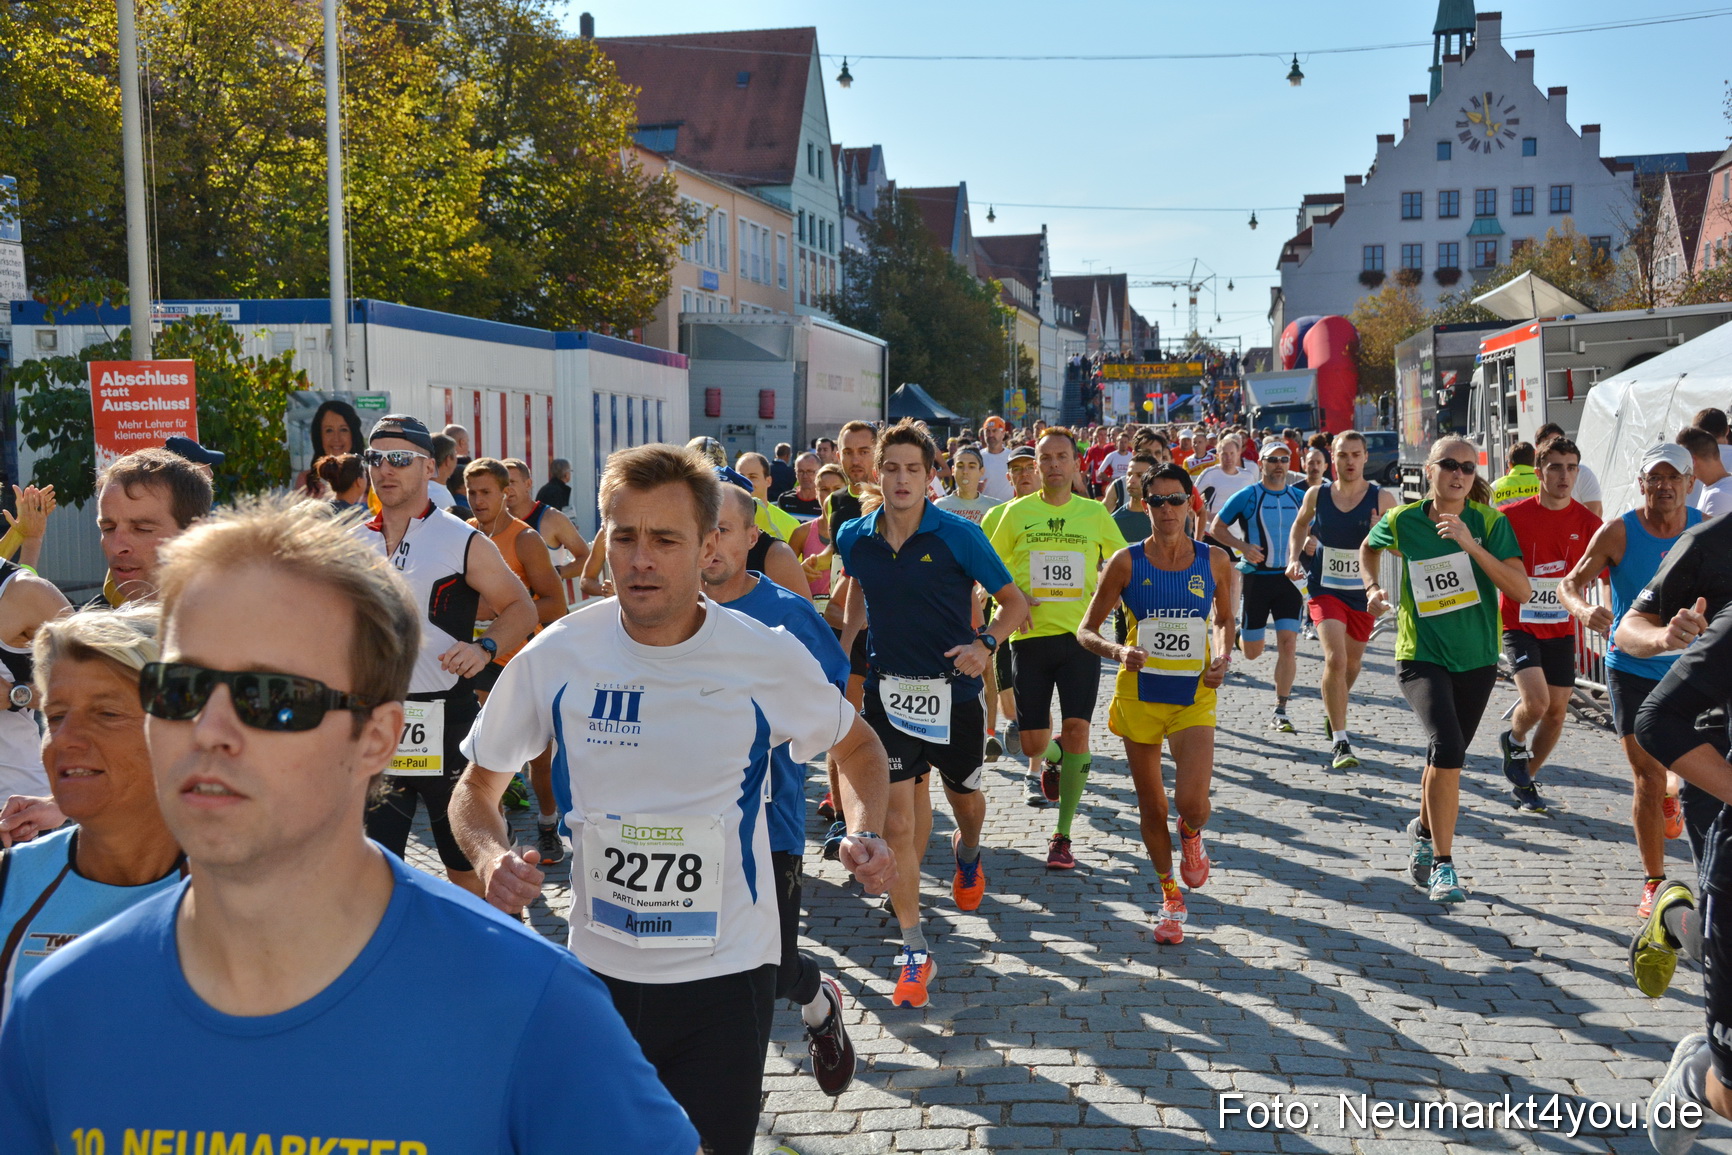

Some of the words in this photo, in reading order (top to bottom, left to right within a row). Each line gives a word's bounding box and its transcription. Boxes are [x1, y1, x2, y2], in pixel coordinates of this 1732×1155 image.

[1135, 366, 1169, 375] START
[100, 370, 188, 386] Abschluss
[100, 387, 130, 397] statt
[101, 397, 190, 412] Ausschluss!
[118, 420, 142, 429] Mehr
[145, 419, 173, 429] Lehrer
[175, 419, 187, 428] für
[114, 430, 152, 440] kleinere
[1496, 486, 1539, 499] Org.-Leit
[1042, 565, 1072, 581] 198
[1329, 559, 1360, 573] 3013
[1425, 571, 1460, 592] 168
[1439, 598, 1456, 608] Sina
[1529, 590, 1561, 604] 246
[1158, 621, 1188, 630] BOCK
[1153, 632, 1190, 651] 326
[899, 682, 930, 692] BOCK
[889, 693, 940, 715] 2420
[589, 719, 641, 734] athlon
[901, 720, 927, 734] Marco
[621, 824, 684, 842] BOCK
[594, 871, 600, 879] A
[604, 847, 703, 893] 2278
[612, 891, 635, 906] PARTL
[636, 899, 680, 907] Neumarkt
[625, 914, 672, 933] Armin
